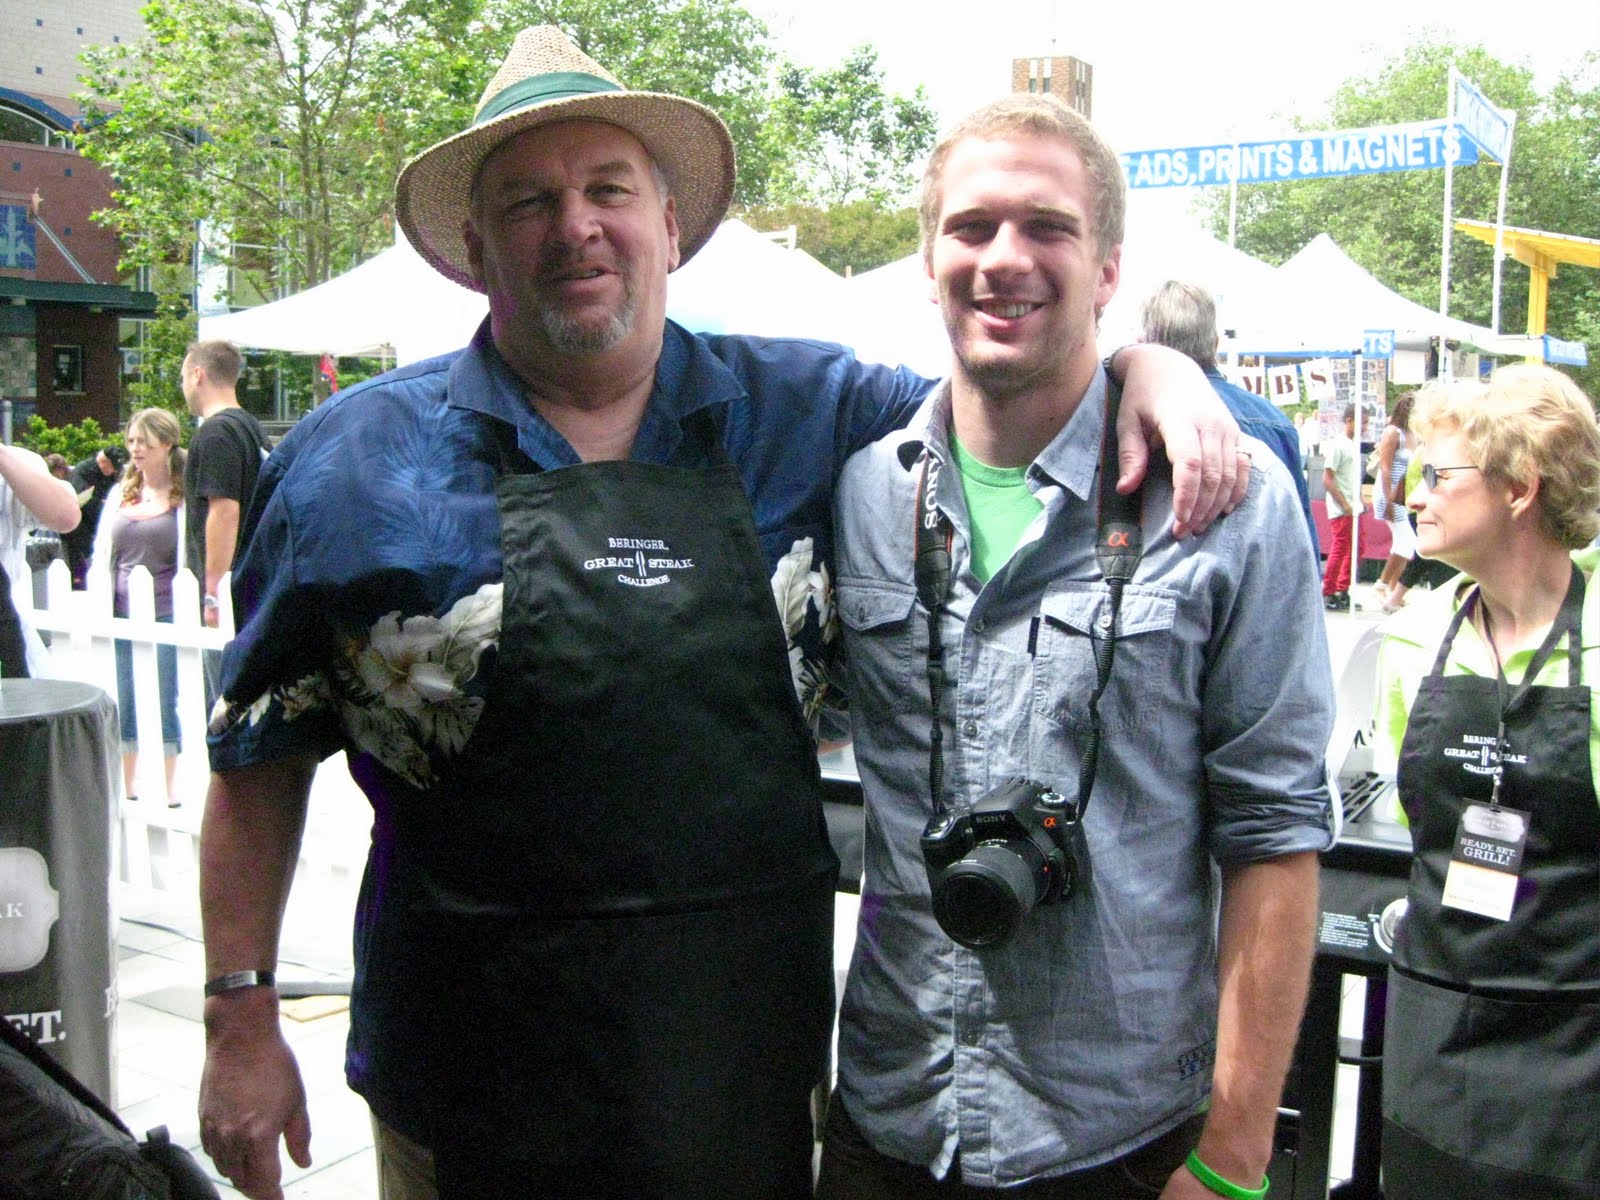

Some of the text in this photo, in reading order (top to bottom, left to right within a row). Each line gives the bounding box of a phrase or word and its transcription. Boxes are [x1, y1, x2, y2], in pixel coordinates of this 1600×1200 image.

[1322, 129, 1461, 174] MAGNETS
[583, 557, 694, 570] GREAT STEAK
[617, 574, 671, 587] CHALLENGE
[1443, 747, 1528, 764] GREAT SEAK
[976, 813, 1006, 824] SONY
[1463, 846, 1511, 866] GRILL!
